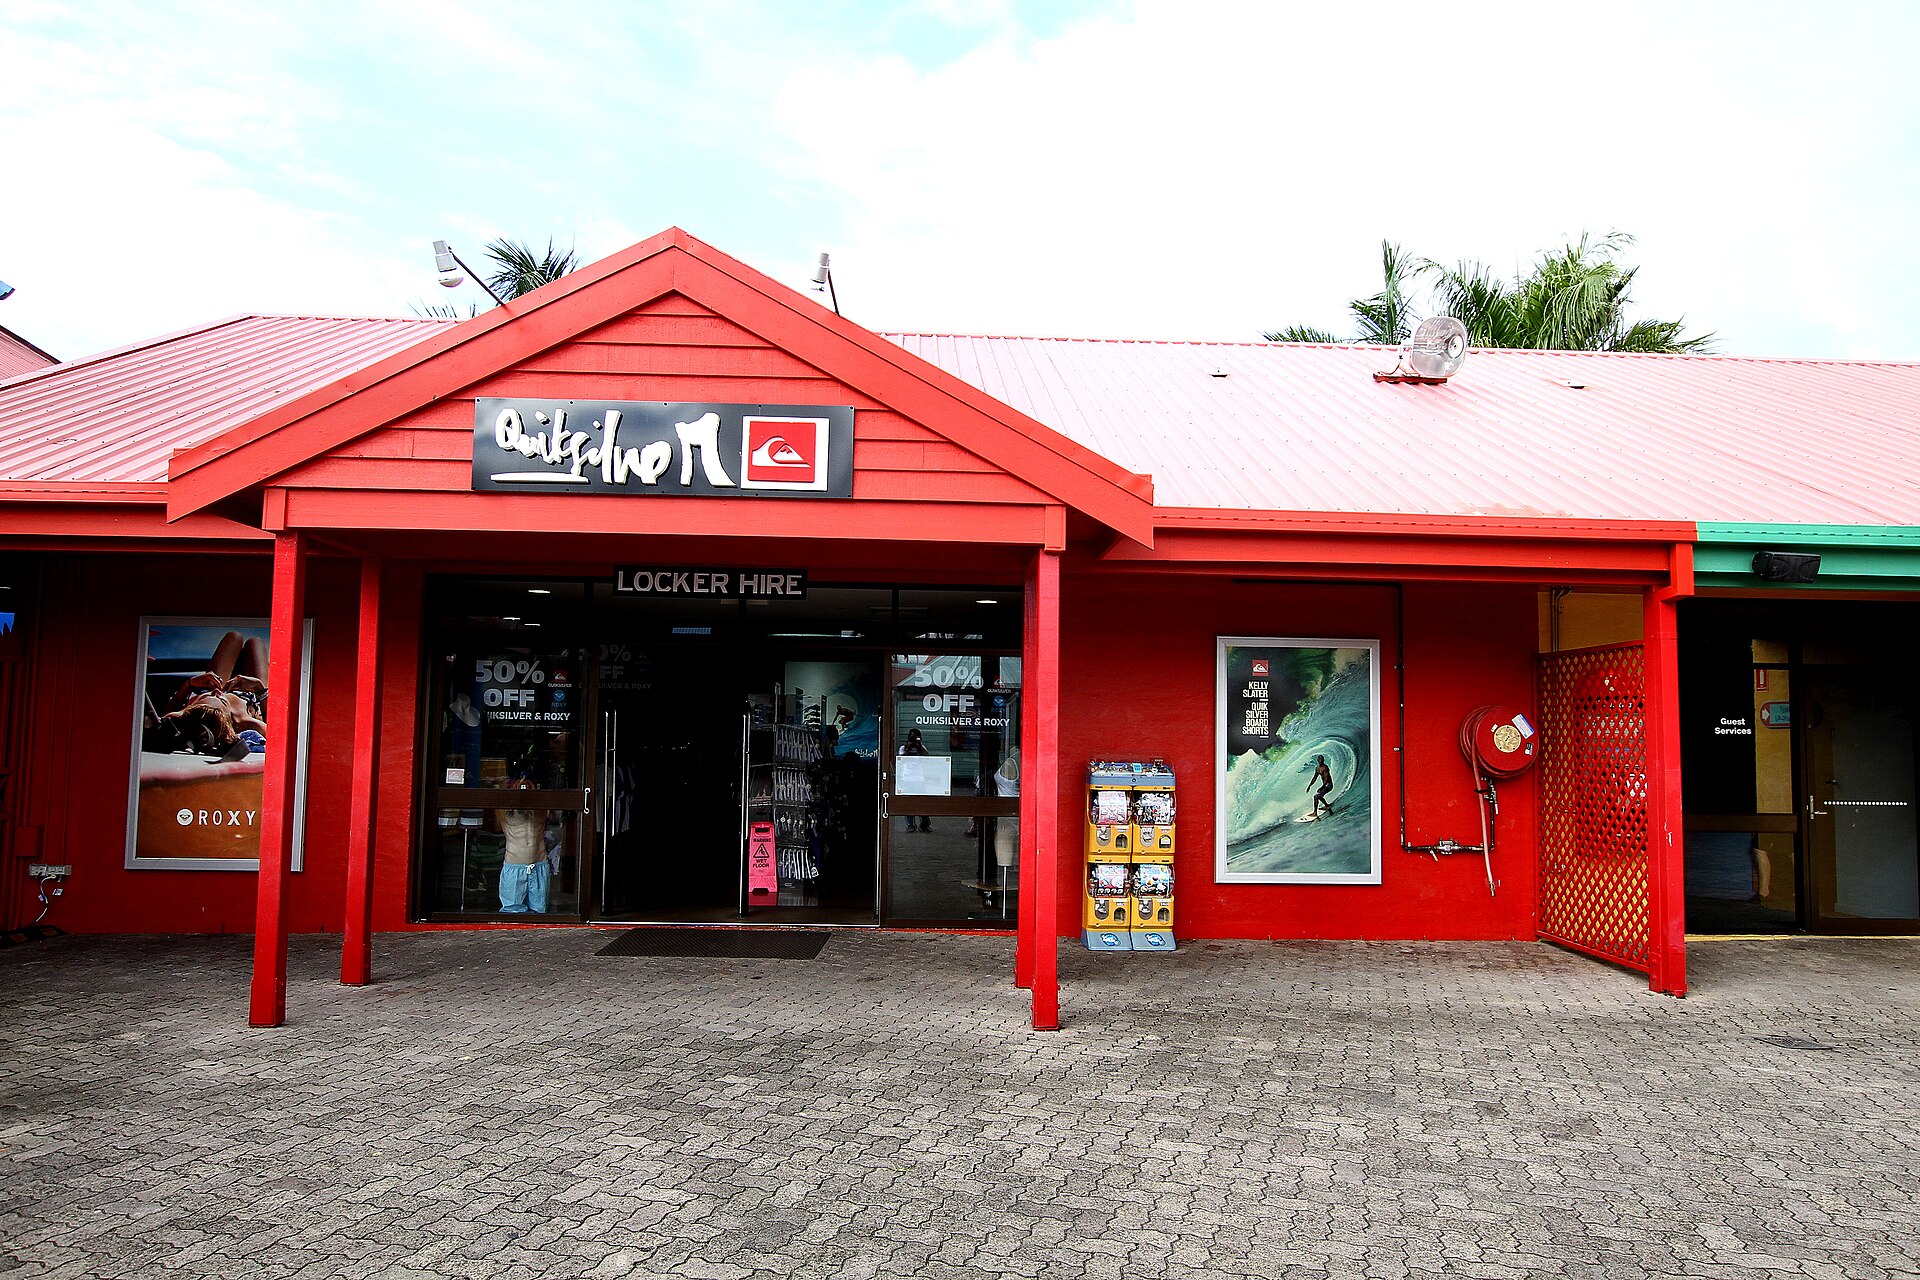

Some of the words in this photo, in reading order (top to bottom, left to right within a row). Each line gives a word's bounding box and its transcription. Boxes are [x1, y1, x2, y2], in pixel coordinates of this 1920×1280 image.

[617, 570, 730, 594] LOCKER
[739, 573, 803, 596] HIRE
[475, 659, 545, 684] 50%
[914, 665, 984, 690] 50%
[1248, 681, 1269, 690] KELLY
[483, 688, 535, 707] OFF
[1242, 689, 1269, 698] SLATER
[922, 693, 975, 713] OFF
[1251, 702, 1269, 711] QUIK
[534, 711, 542, 721] &
[543, 712, 571, 721] ROXY
[1245, 710, 1269, 719] SILVER
[915, 716, 972, 726] QUIKSILVER
[974, 718, 982, 726] &
[984, 717, 1010, 727] ROXY
[1245, 718, 1269, 727] BOARD
[1720, 717, 1746, 726] Guest
[1242, 726, 1269, 735] SHORTS
[1714, 726, 1752, 735] Services
[198, 809, 256, 827] ROXY
